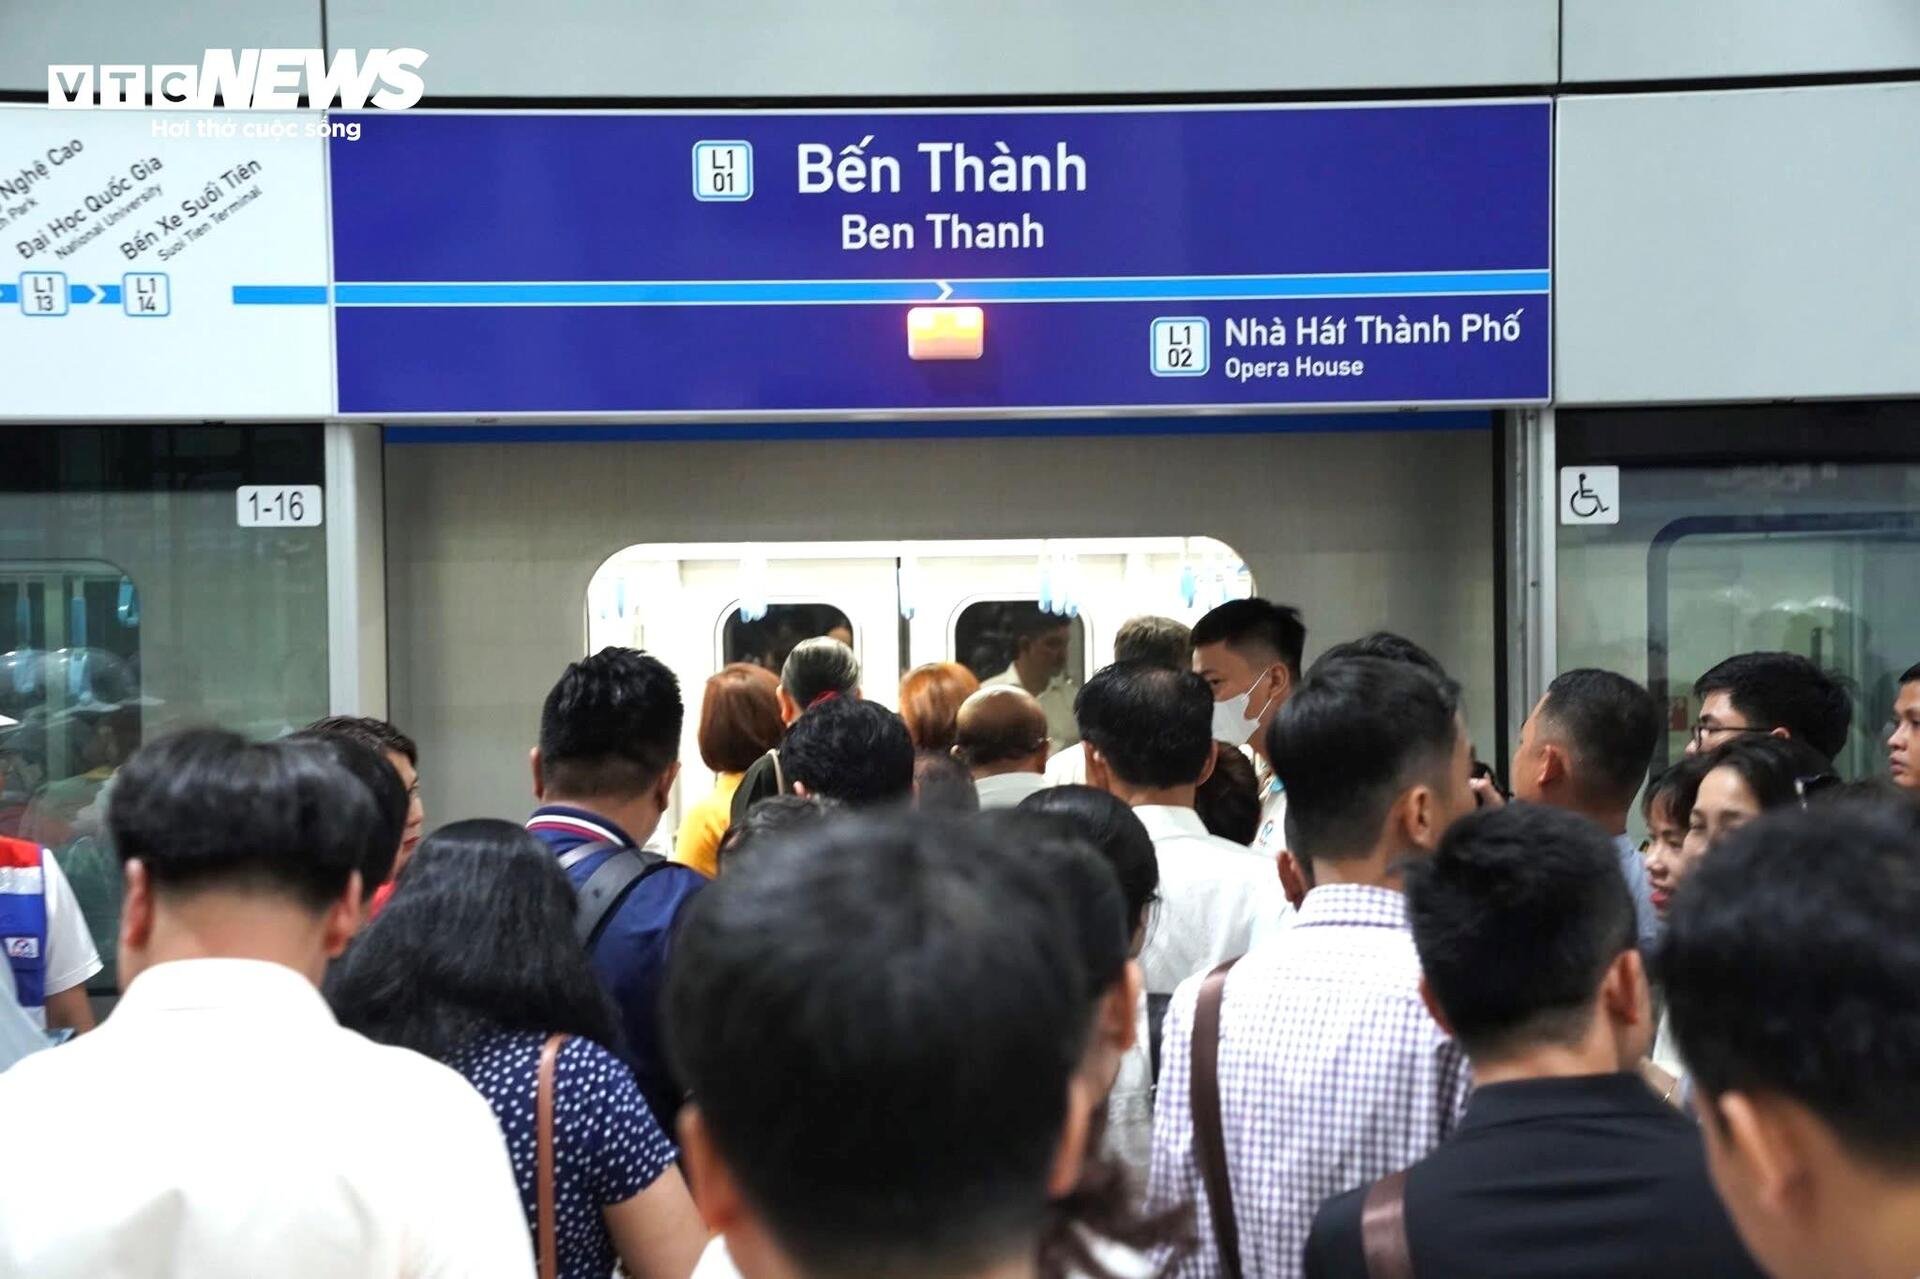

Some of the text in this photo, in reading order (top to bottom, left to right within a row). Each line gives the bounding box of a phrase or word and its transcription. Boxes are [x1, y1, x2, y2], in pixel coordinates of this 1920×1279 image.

[47, 139, 84, 166] Cao
[711, 149, 734, 169] L1
[798, 135, 1087, 194] Bến Thành
[712, 172, 734, 193] 01
[16, 157, 163, 260] Đại Học Quốc Gia
[120, 229, 160, 260] Bến
[155, 214, 184, 236] Xe
[842, 212, 1045, 249] Ben Thanh
[33, 276, 54, 293] L1
[137, 277, 156, 294] L1
[35, 295, 54, 312] 13
[138, 295, 156, 312] 14
[1170, 326, 1191, 345] L1
[1225, 308, 1524, 347] Nhà Hát Thành Phố
[1168, 348, 1192, 368] 02
[1225, 356, 1364, 383] Opera House
[248, 490, 304, 522] 1-16
